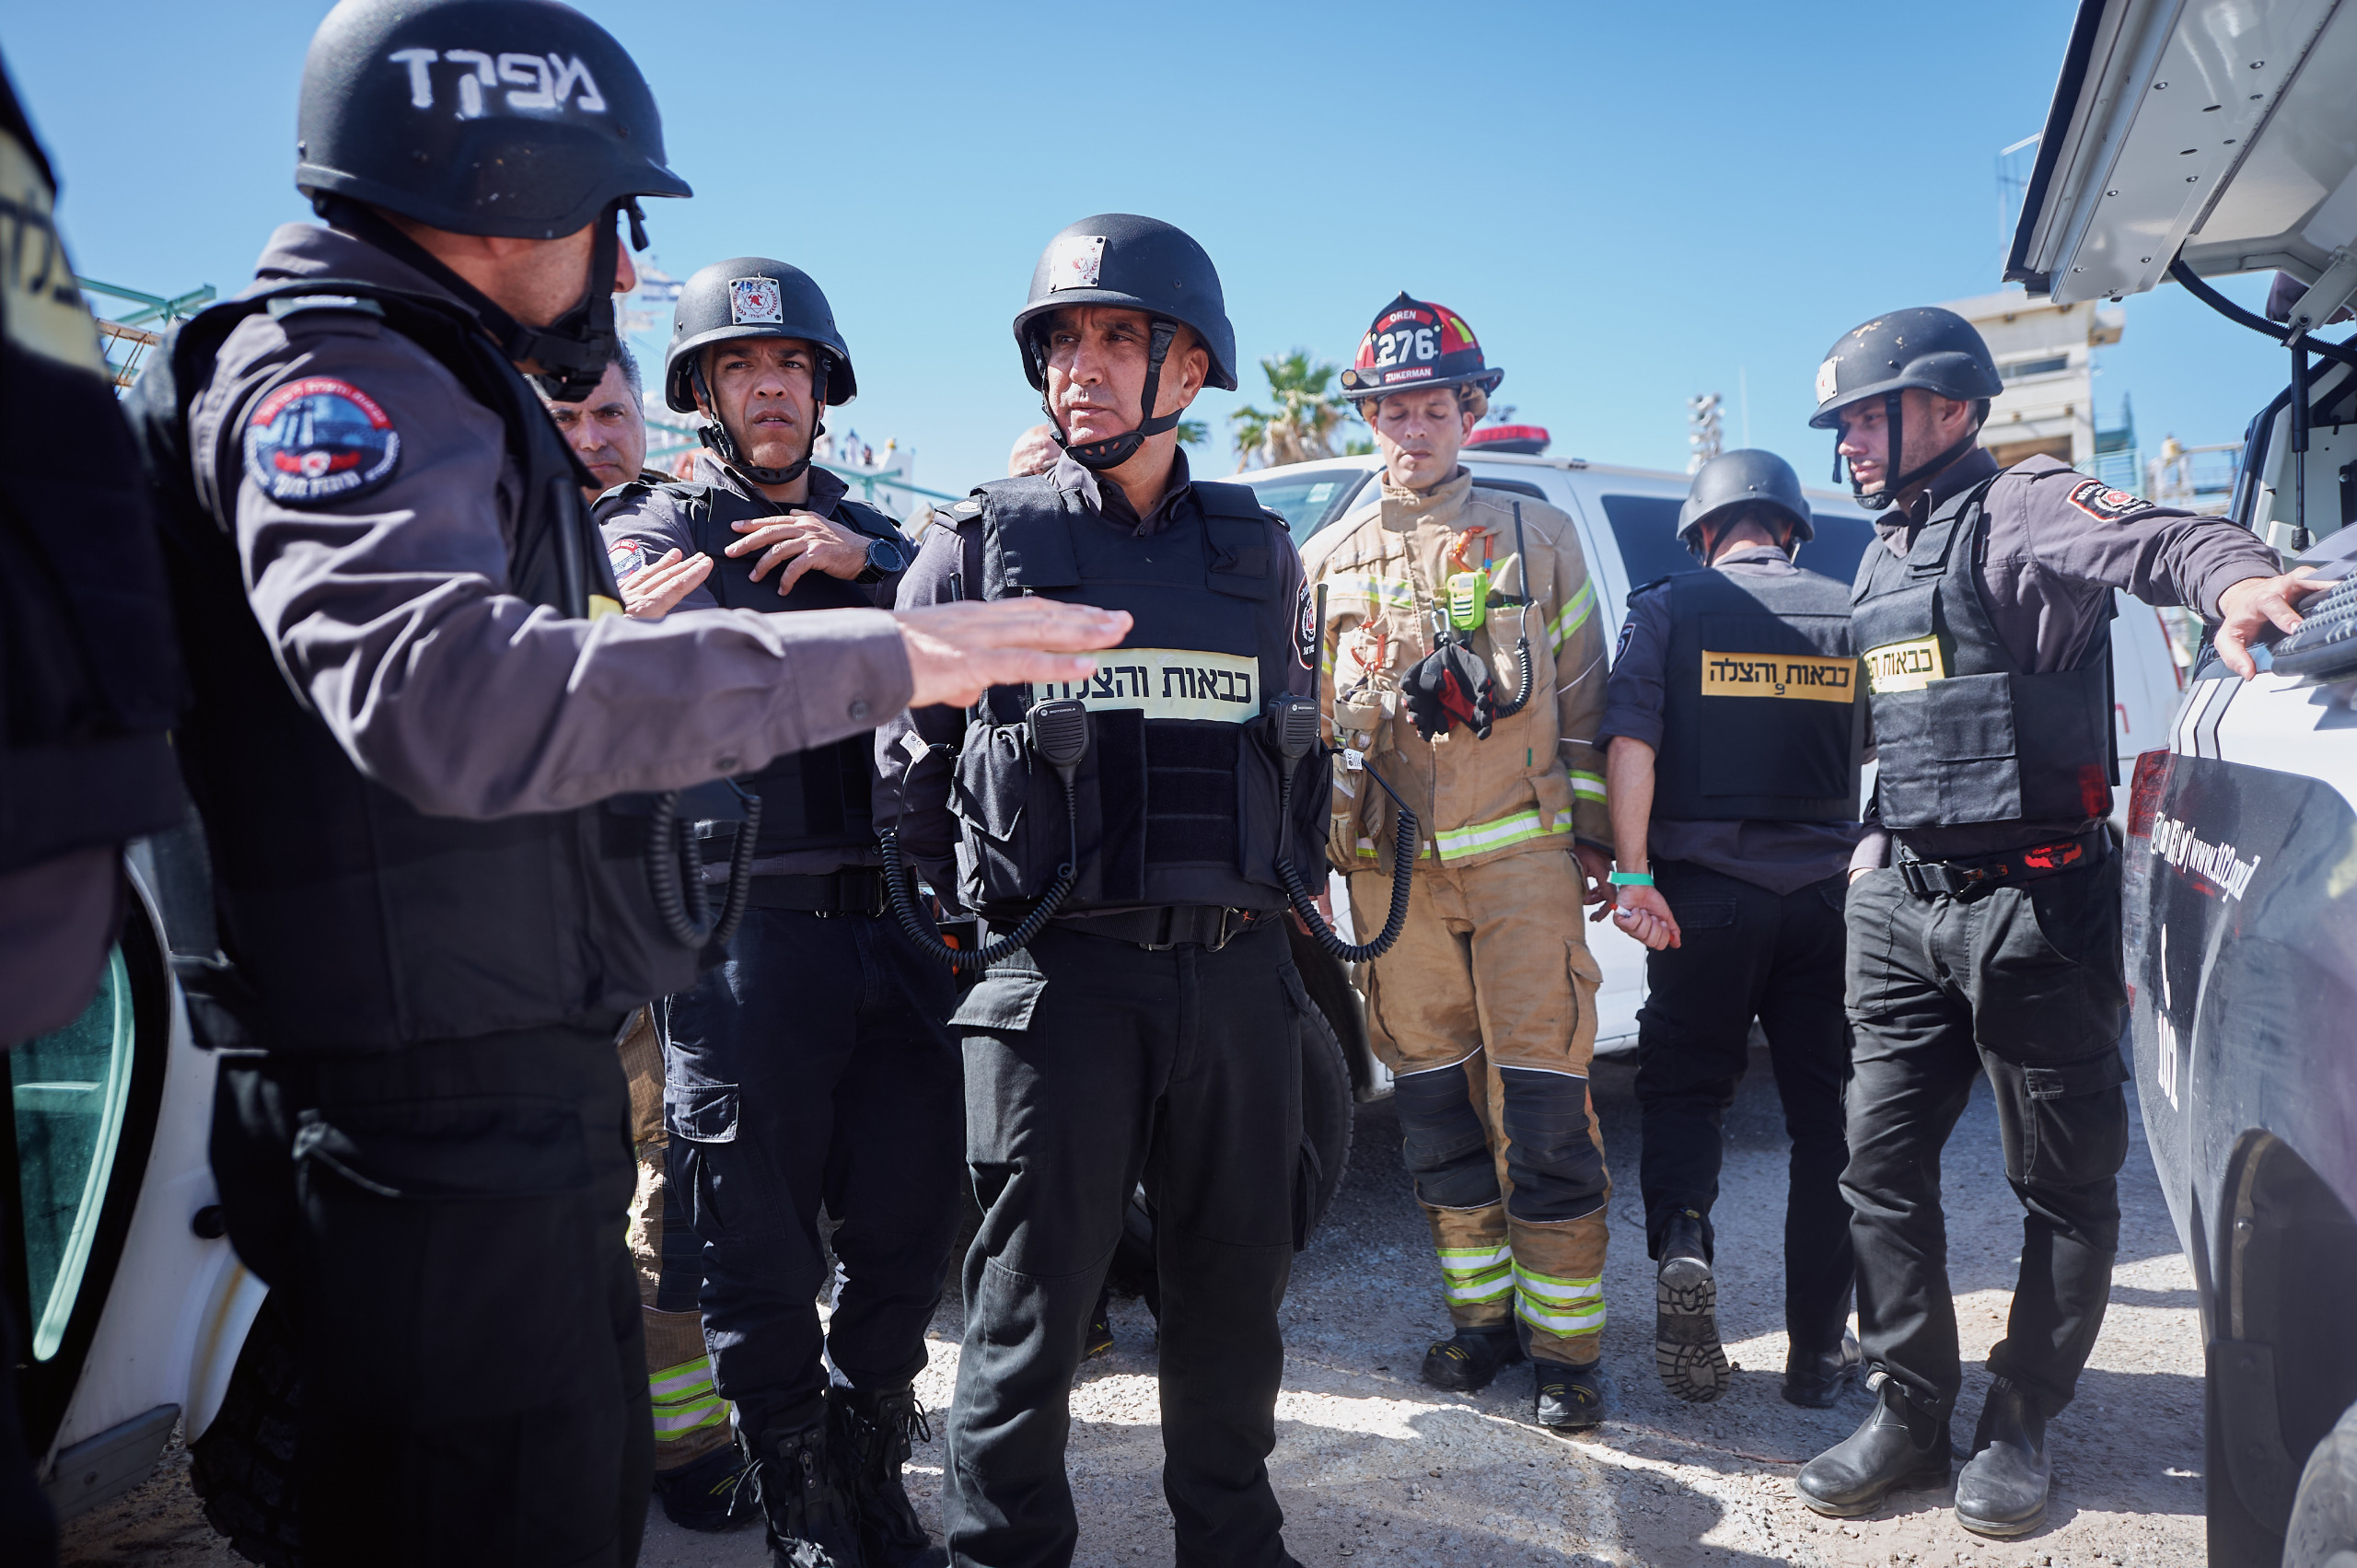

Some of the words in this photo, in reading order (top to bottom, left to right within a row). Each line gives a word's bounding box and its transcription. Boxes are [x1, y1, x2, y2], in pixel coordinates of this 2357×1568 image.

[388, 48, 607, 120] מפקד
[1389, 309, 1417, 322] OREN
[1376, 328, 1434, 367] 276
[1385, 368, 1432, 382] ZUKERMAN
[1710, 657, 1777, 683] והצלה
[1784, 664, 1850, 688] כבאות
[1883, 648, 1933, 677] כבאות
[1162, 667, 1251, 703] כבאות
[2157, 1010, 2178, 1112] 102
